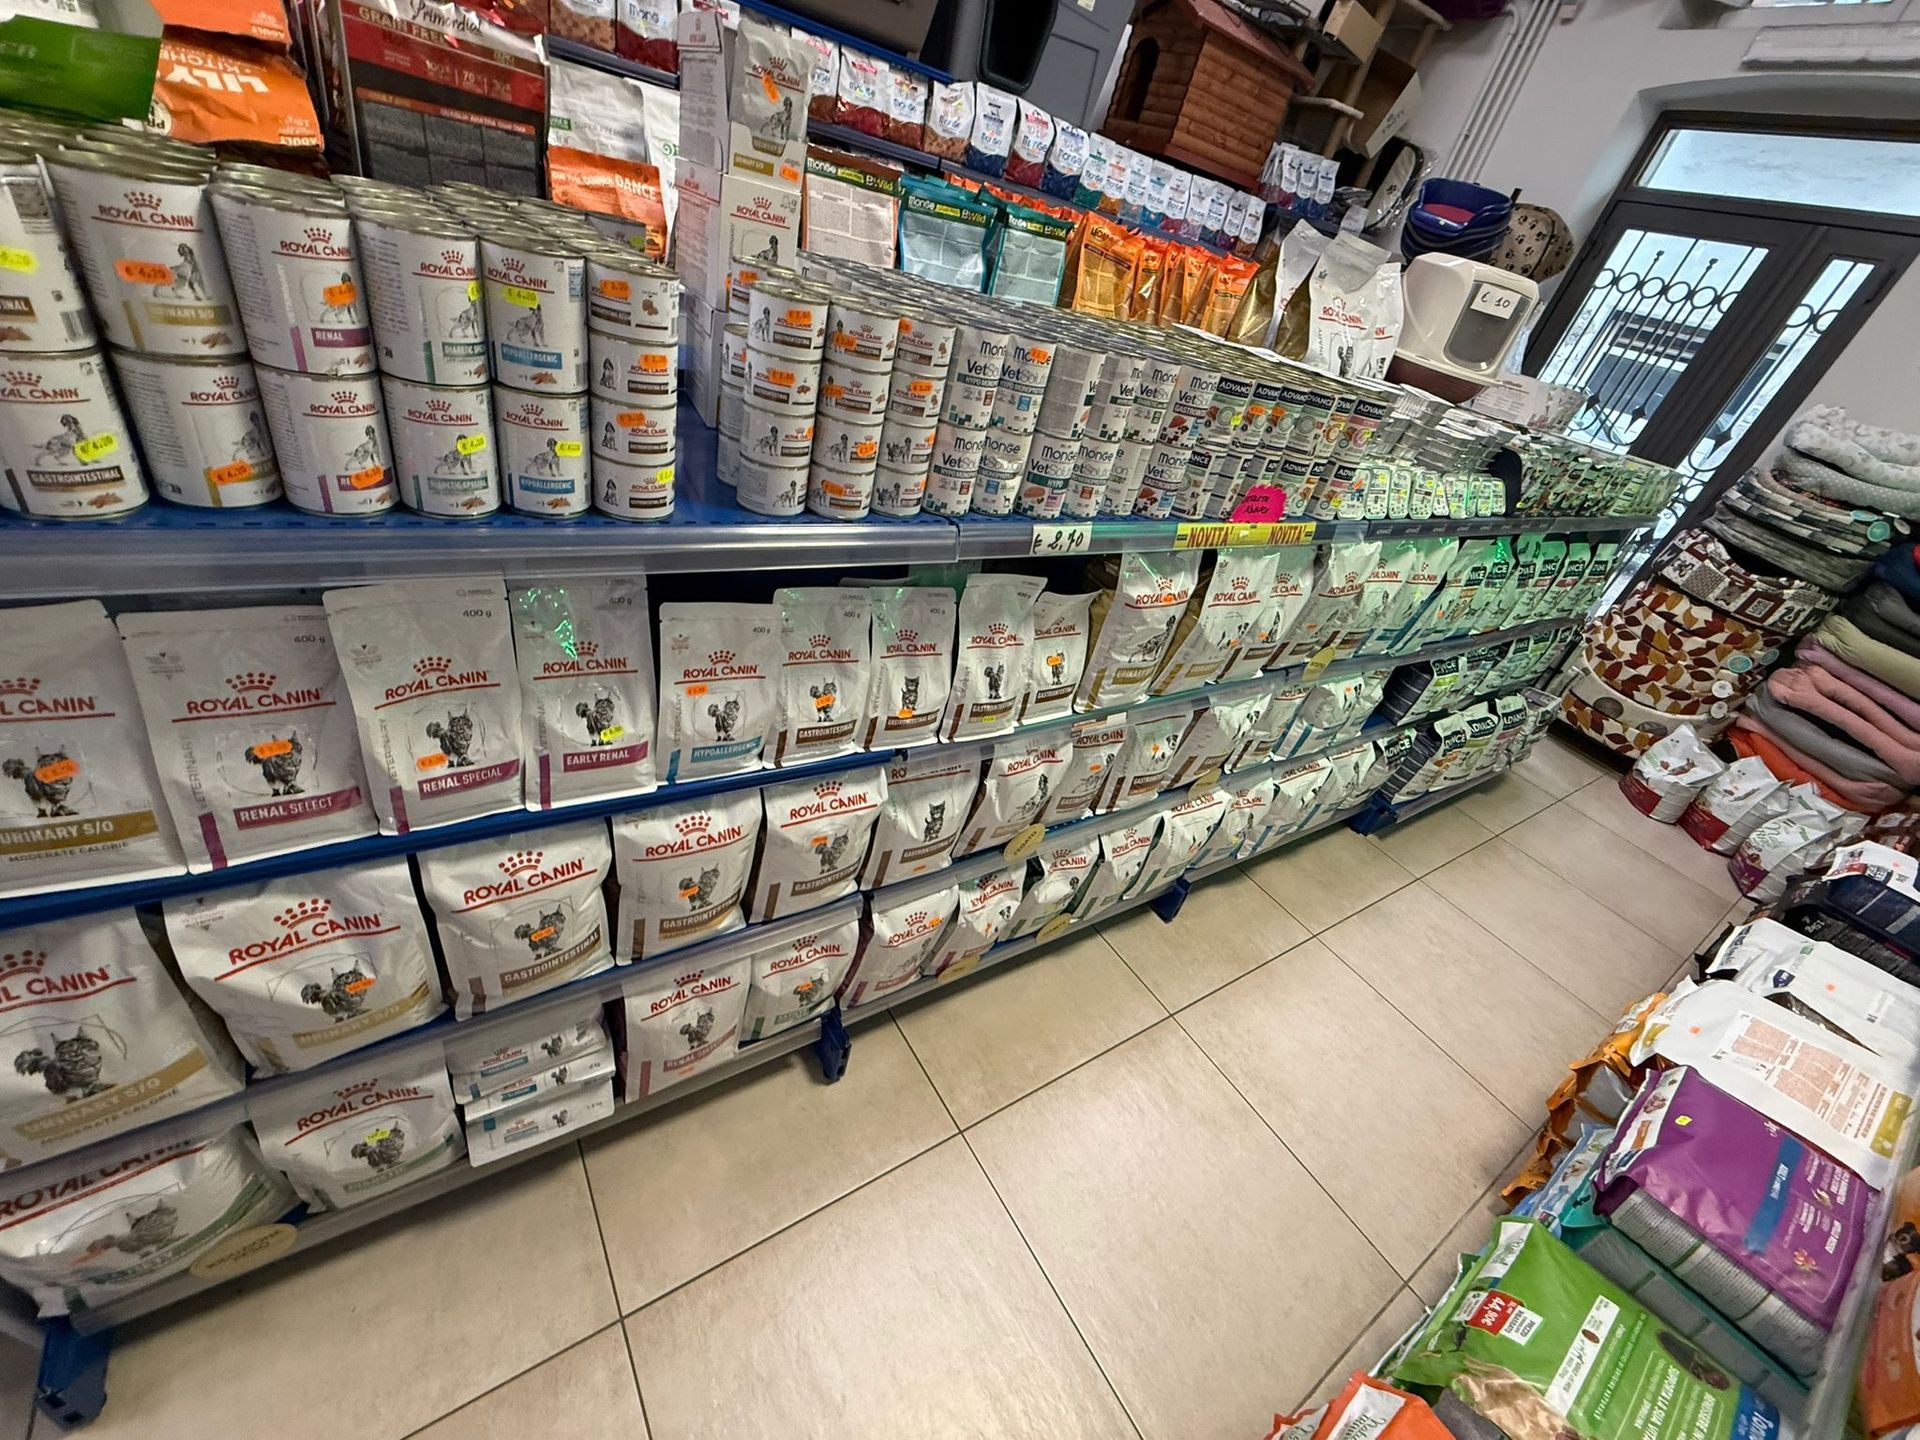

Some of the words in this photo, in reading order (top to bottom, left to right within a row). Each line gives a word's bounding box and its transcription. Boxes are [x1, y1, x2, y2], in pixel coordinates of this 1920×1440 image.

[359, 8, 408, 35] GRAIN
[165, 64, 270, 94] LILY
[279, 136, 320, 146] ADULT
[97, 204, 149, 224] ROYAL
[150, 213, 195, 228] CANIN
[735, 205, 760, 220] ROYAL
[761, 211, 786, 225] CANIN
[279, 240, 321, 256] ROYAL
[420, 261, 454, 276] ROYAL
[487, 266, 520, 285] ROYAL
[520, 275, 548, 290] CANIN
[1494, 297, 1511, 309] 10
[315, 331, 344, 341] RENAL
[29, 387, 79, 400] CANIN
[190, 390, 231, 402] ROYAL
[310, 404, 345, 415] ROYAL
[407, 408, 438, 422] ROYAL
[438, 411, 473, 424] CANIN
[505, 410, 533, 424] ROYAL
[534, 415, 563, 427] CANIN
[30, 468, 121, 484] GASTROINTESTINAL
[1266, 524, 1307, 546] NOVITA'
[1135, 593, 1163, 605] ROYAL
[1213, 592, 1236, 602] ROYAL
[1237, 591, 1258, 601] CANIN
[463, 609, 483, 618] 400
[485, 610, 493, 619] g
[843, 611, 856, 619] 400
[929, 607, 941, 615] 400
[752, 626, 766, 634] 400
[1054, 624, 1076, 634] CANIN
[908, 642, 937, 653] CANIN
[971, 634, 997, 646] ROYAL
[788, 649, 818, 661] ROYAL
[818, 648, 852, 660] CANIN
[542, 658, 584, 674] ROYAL
[586, 656, 628, 670] CANIN
[682, 666, 718, 679] ROYAL
[719, 664, 758, 677] CANIN
[384, 679, 433, 701] ROYAL
[434, 670, 488, 687] CANIN
[18, 696, 97, 713] CANIN
[186, 696, 253, 715] ROYAL
[257, 688, 321, 708] CANIN
[566, 751, 598, 766] EARLY
[599, 749, 630, 763] RENAL
[1007, 760, 1032, 774] ROYAL
[422, 775, 461, 793] RENAL
[461, 767, 503, 784] SPECIAL
[240, 805, 287, 823] RENAL
[289, 796, 333, 814] SELECT
[789, 802, 828, 820] ROYAL
[830, 793, 868, 810] CANIN
[85, 821, 114, 838] S/O
[79, 841, 129, 857] CALORIE
[645, 838, 694, 858] ROYAL
[696, 825, 742, 847] CANIN
[1059, 855, 1087, 869] CANIN
[463, 882, 520, 905] ROYAL
[527, 858, 583, 888] CANIN
[228, 931, 307, 966] ROYAL
[311, 913, 382, 936] CANIN
[888, 927, 917, 945] ROYAL
[504, 930, 599, 982] GASTROINTESTINAL
[770, 953, 803, 971] ROYAL
[804, 943, 840, 961] CANIN
[27, 968, 111, 996] CANIN
[650, 992, 689, 1014] ROYAL
[690, 976, 732, 997] CANIN
[297, 1105, 359, 1132] ROYAL
[361, 1086, 419, 1105] CANIN
[1479, 1294, 1507, 1329] 44,90€
[1519, 1318, 1536, 1339] PREZZO
[1656, 1365, 1683, 1399] SUPPORTA
[1592, 1388, 1615, 1421] NATURALE
[1655, 1396, 1668, 1409] LA
[1648, 1406, 1667, 1426] SUA
